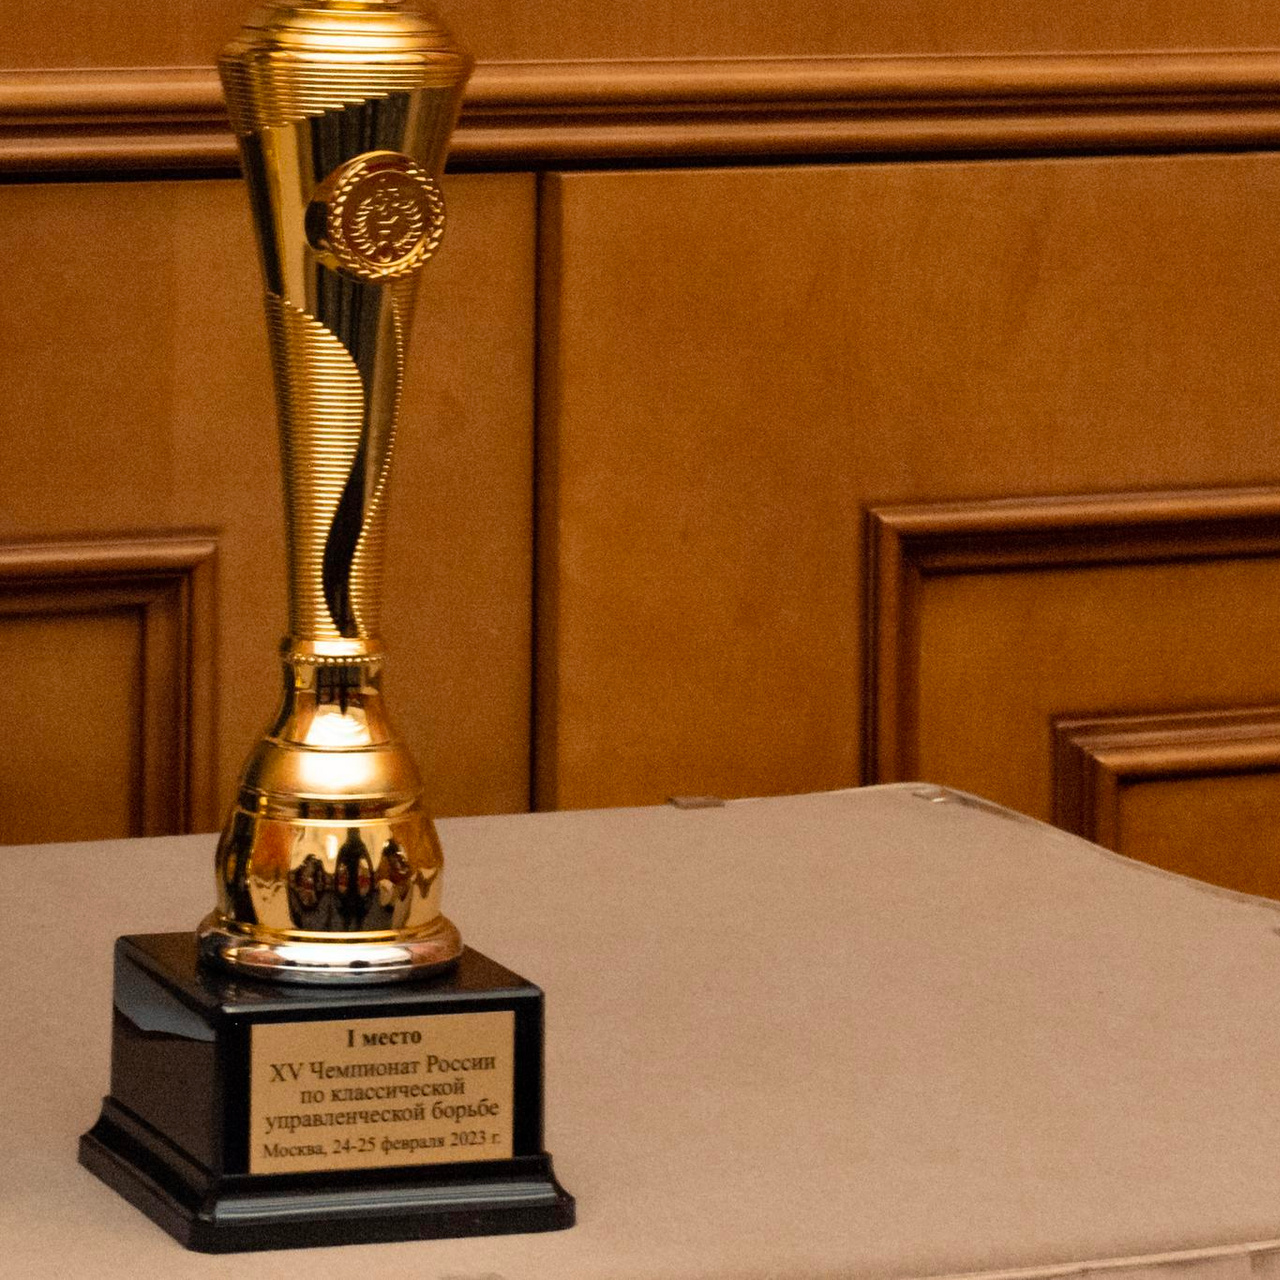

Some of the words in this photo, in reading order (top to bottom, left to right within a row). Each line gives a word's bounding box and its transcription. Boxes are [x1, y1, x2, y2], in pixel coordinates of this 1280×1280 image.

[347, 1029, 355, 1048] I
[362, 1029, 423, 1046] место
[270, 1063, 304, 1082] XV
[309, 1061, 420, 1080] Чемпионат
[426, 1055, 496, 1072] России
[300, 1089, 325, 1104] по
[330, 1078, 466, 1102] классической
[265, 1104, 425, 1134] управленческой
[431, 1098, 500, 1123] борьбе
[332, 1137, 375, 1154] 24-25
[380, 1136, 444, 1155] февраля
[450, 1130, 486, 1146] 2023
